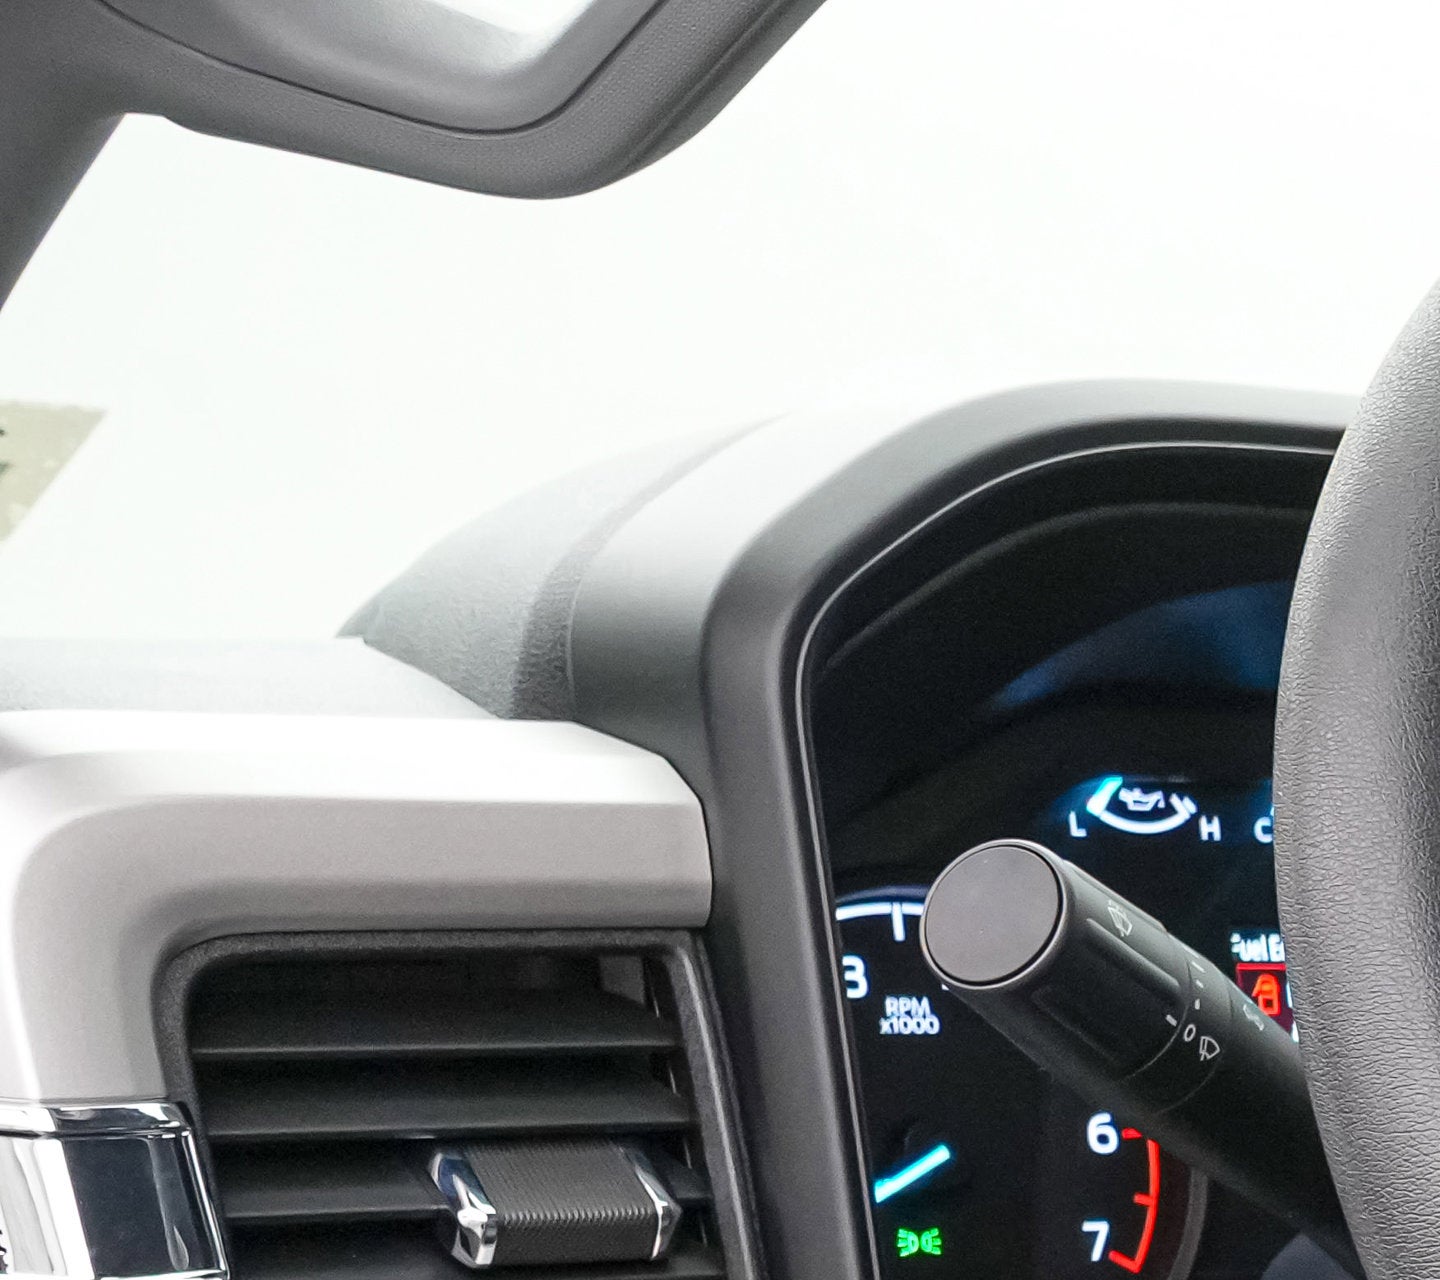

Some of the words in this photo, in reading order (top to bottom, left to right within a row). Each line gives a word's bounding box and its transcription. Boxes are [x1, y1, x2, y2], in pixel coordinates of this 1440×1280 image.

[1068, 811, 1087, 838] L
[1200, 814, 1222, 841] H
[842, 954, 869, 999] 3
[885, 995, 931, 1017] RPM
[1087, 1112, 1119, 1155] 6
[1081, 1220, 1110, 1263] 7
